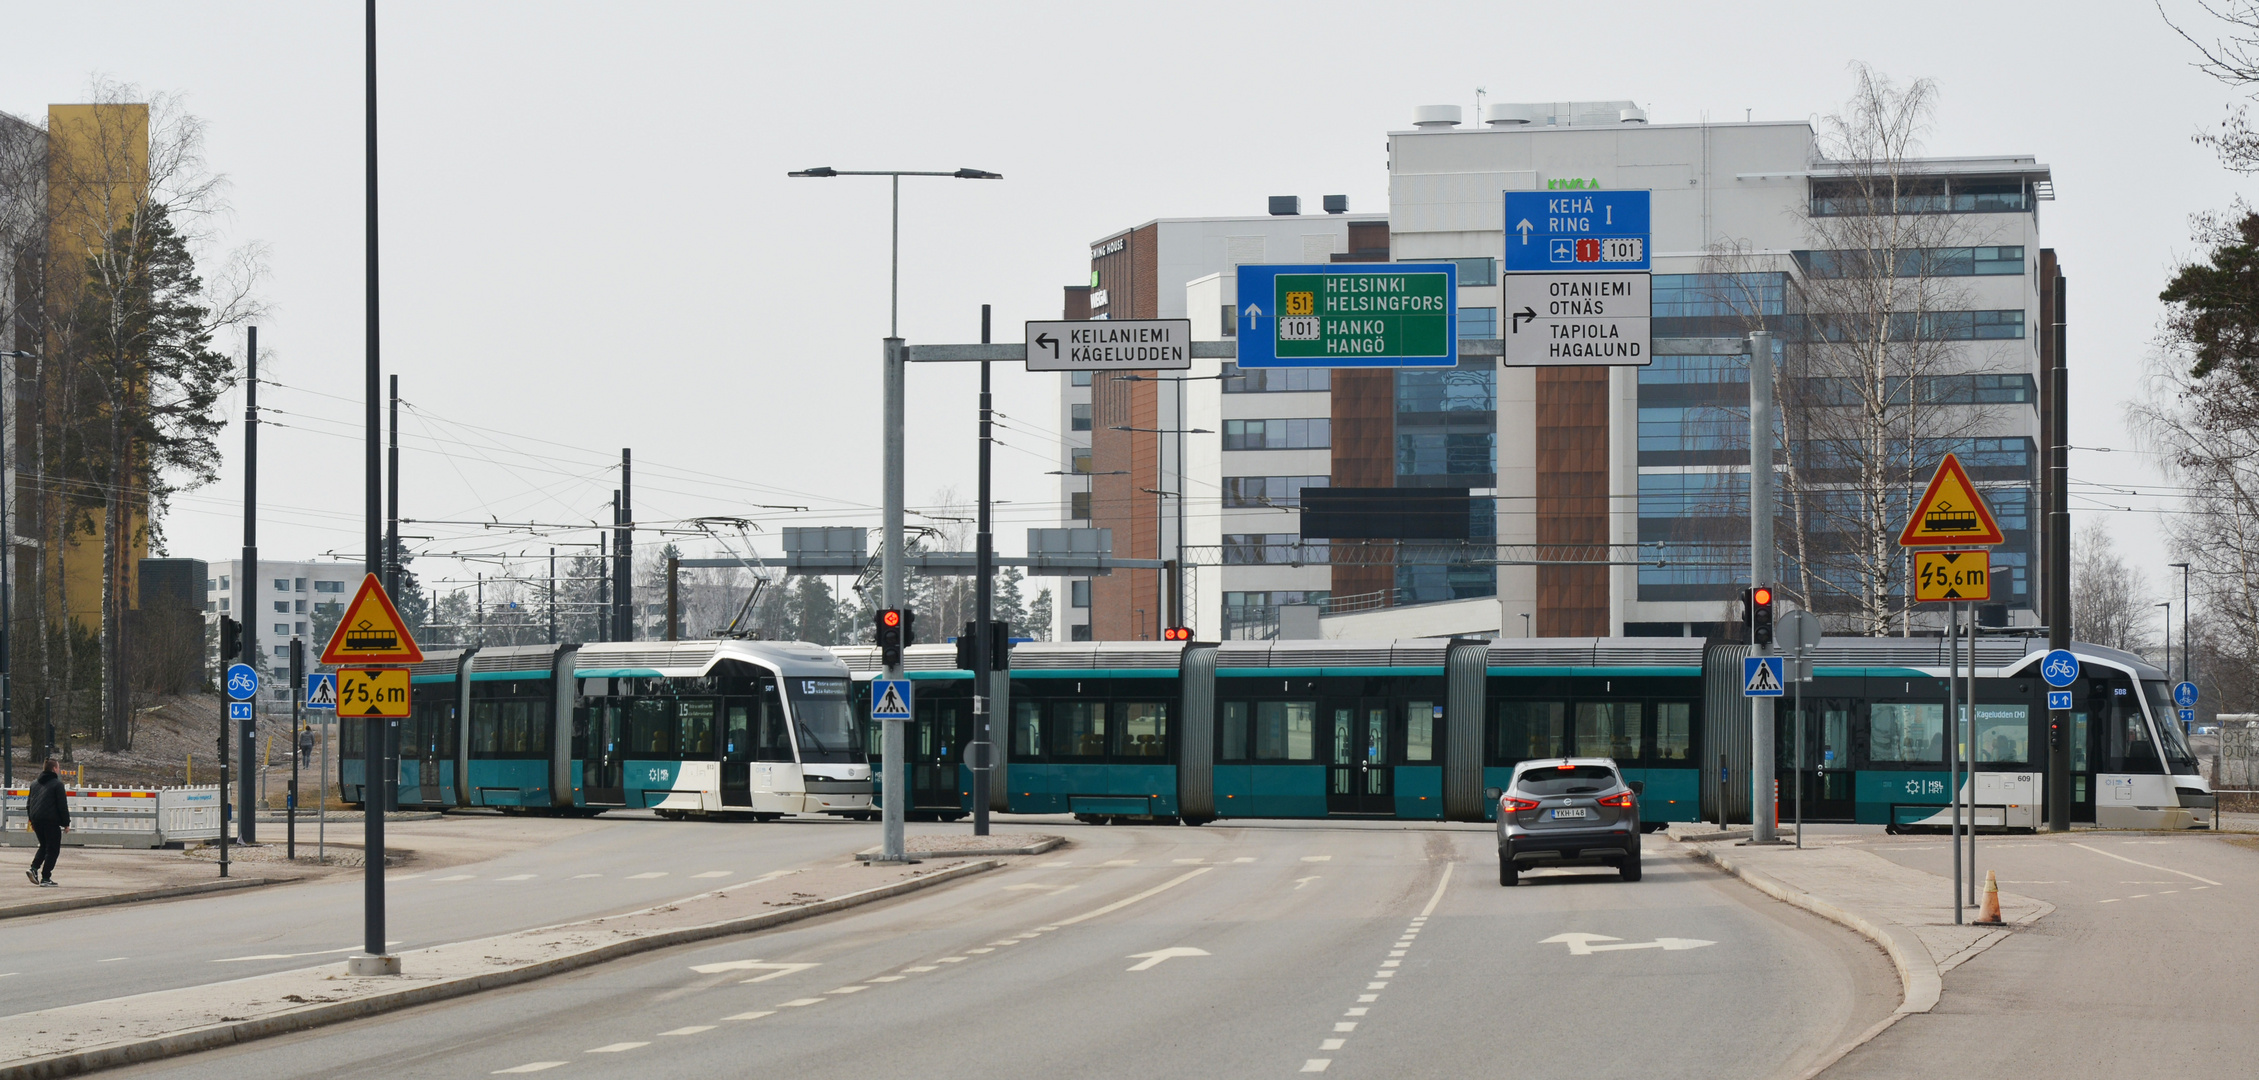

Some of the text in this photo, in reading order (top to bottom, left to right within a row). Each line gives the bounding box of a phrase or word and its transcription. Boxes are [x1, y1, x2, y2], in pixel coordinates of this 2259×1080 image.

[1550, 196, 1594, 213] KEHÄ
[1606, 205, 1612, 225] I
[1550, 217, 1590, 232] RING
[1107, 238, 1124, 255] HOUSE
[1585, 243, 1634, 258] 1 101
[1326, 278, 1405, 292] HELSINKI
[1550, 282, 1631, 297] OTANIEMI
[1292, 297, 1308, 310] 51
[1326, 296, 1444, 311] HELSINGFORS
[1550, 298, 1604, 315] OTNÄS
[1289, 321, 1312, 336] 101
[1327, 320, 1385, 335] HANKO
[1550, 324, 1619, 339] TAPIOLA
[1071, 328, 1169, 344] KEILANIEMI
[1327, 336, 1385, 353] HANGÖ
[1550, 342, 1641, 357] HAGALUND
[1071, 345, 1182, 361] KÄGELUDDEN
[1936, 566, 1984, 588] 5,6 m
[358, 683, 405, 704] 5,6 m
[679, 703, 688, 716] 15
[1556, 809, 1585, 817] YKH-148
